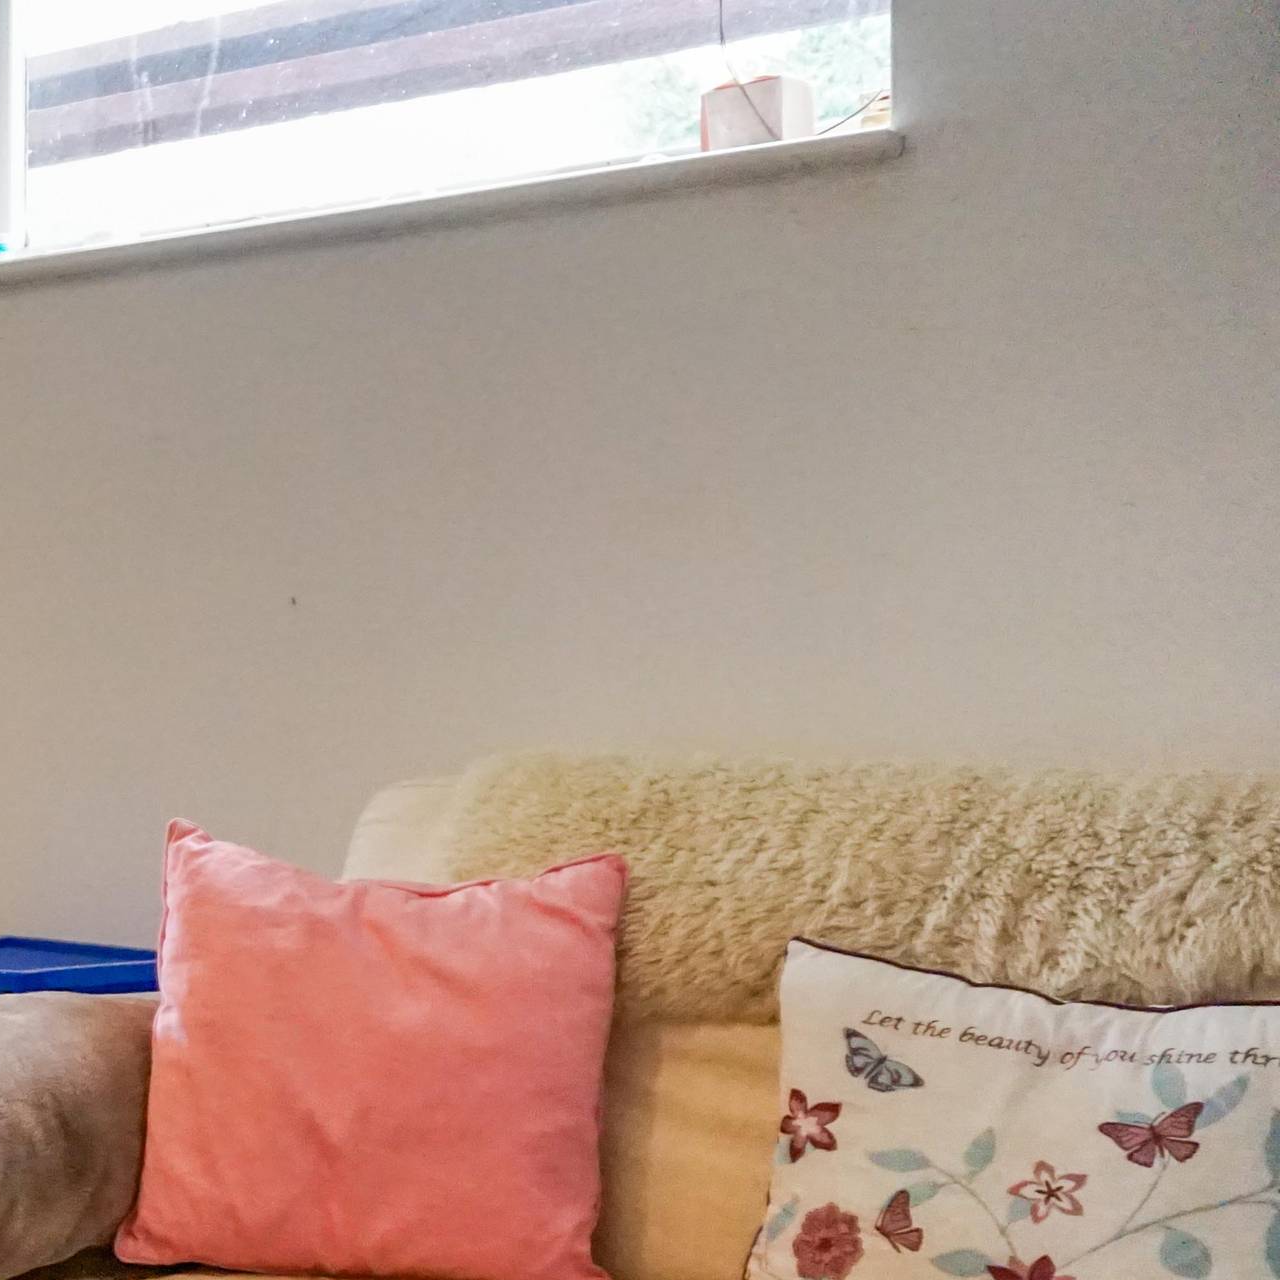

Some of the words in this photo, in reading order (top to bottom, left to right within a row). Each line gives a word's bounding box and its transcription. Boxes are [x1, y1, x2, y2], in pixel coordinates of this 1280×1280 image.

[861, 1009, 905, 1031] Let
[912, 1019, 953, 1039] the
[958, 1026, 1051, 1068] beauty
[1059, 1045, 1092, 1072] of
[1143, 1048, 1218, 1066] shine
[1229, 1047, 1280, 1068] thr
